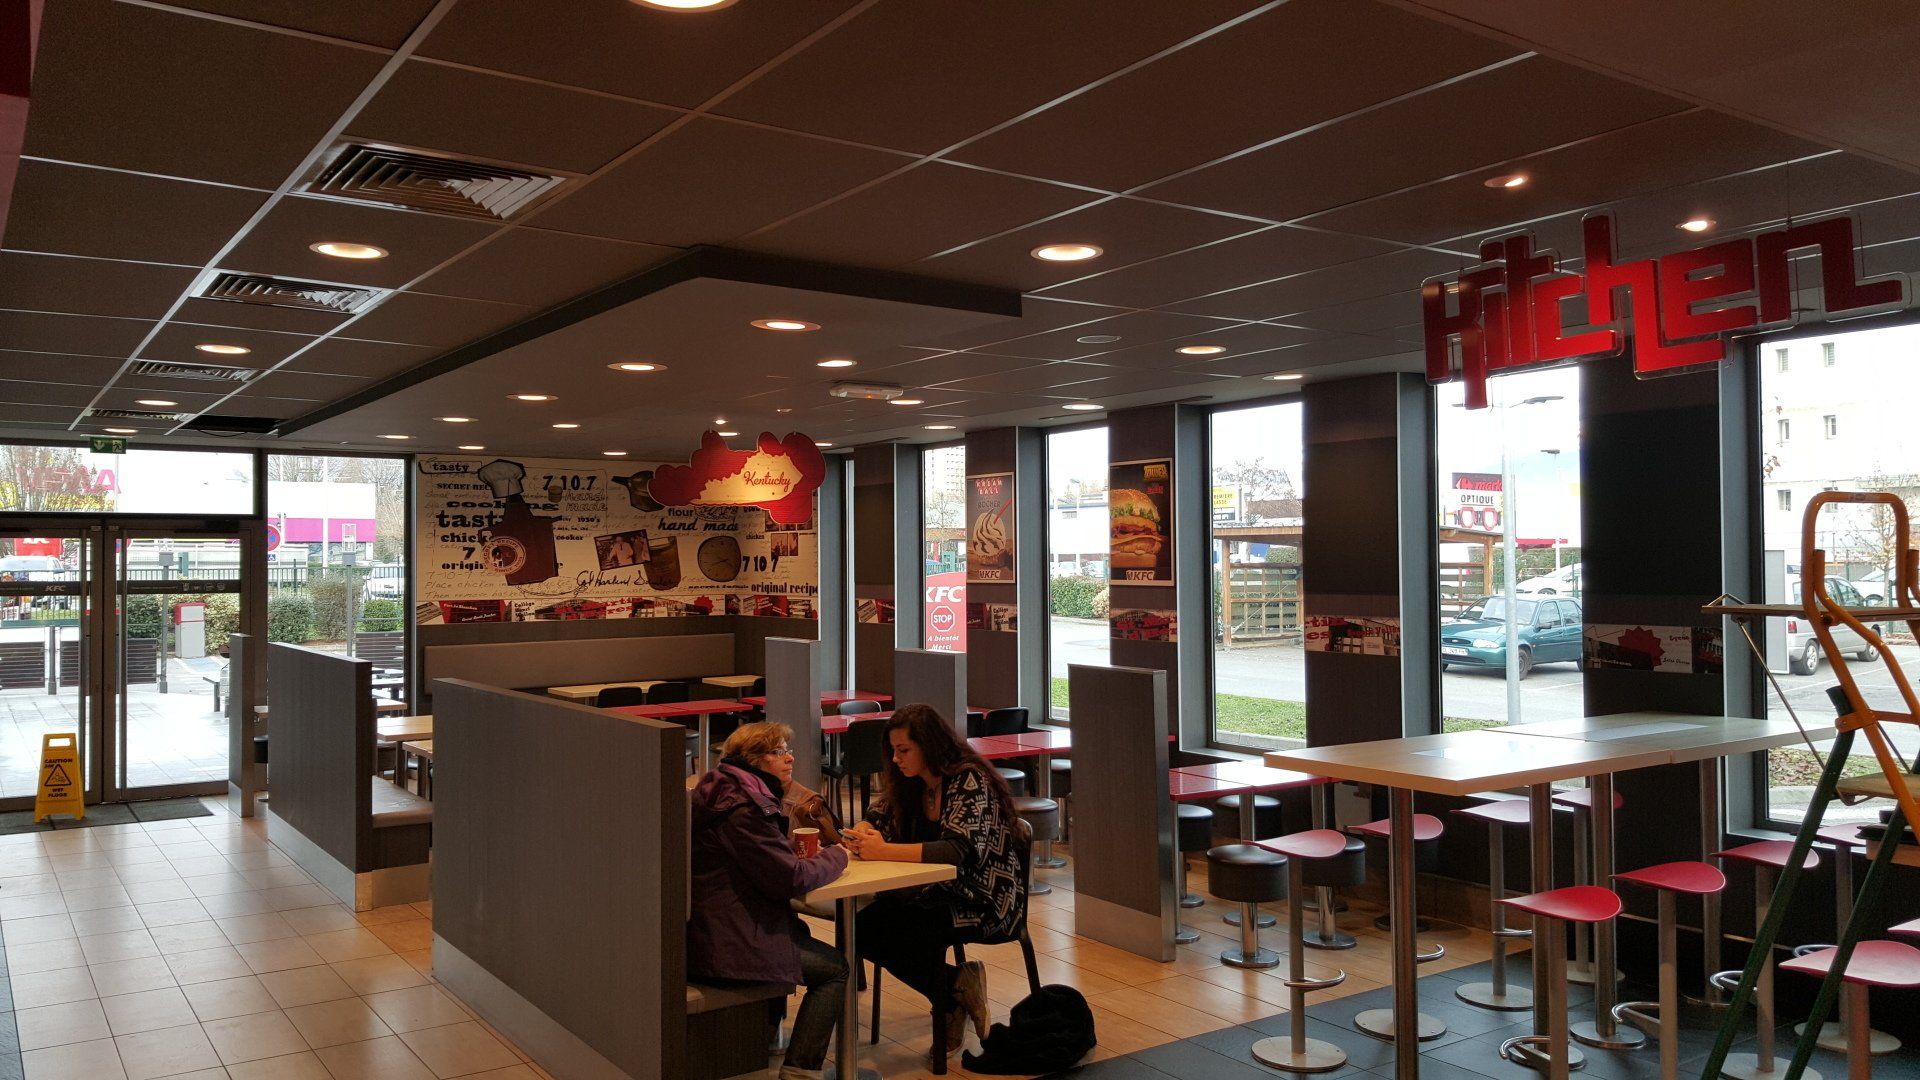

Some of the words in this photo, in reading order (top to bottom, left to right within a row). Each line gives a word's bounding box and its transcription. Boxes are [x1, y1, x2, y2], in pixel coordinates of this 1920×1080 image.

[1422, 213, 1903, 411] Kitchen
[432, 462, 470, 473] tasty
[436, 483, 470, 491] SECRET
[743, 470, 792, 493] Kentucky
[1460, 494, 1495, 505] OPTIQUE
[667, 507, 695, 517] flour
[435, 509, 503, 528] tast
[657, 517, 699, 532] hand
[462, 547, 476, 561] 7
[984, 571, 1001, 579] KFC
[1133, 571, 1154, 581] KFC
[751, 581, 788, 594] original
[926, 586, 964, 604] KFC
[933, 614, 953, 624] STOP
